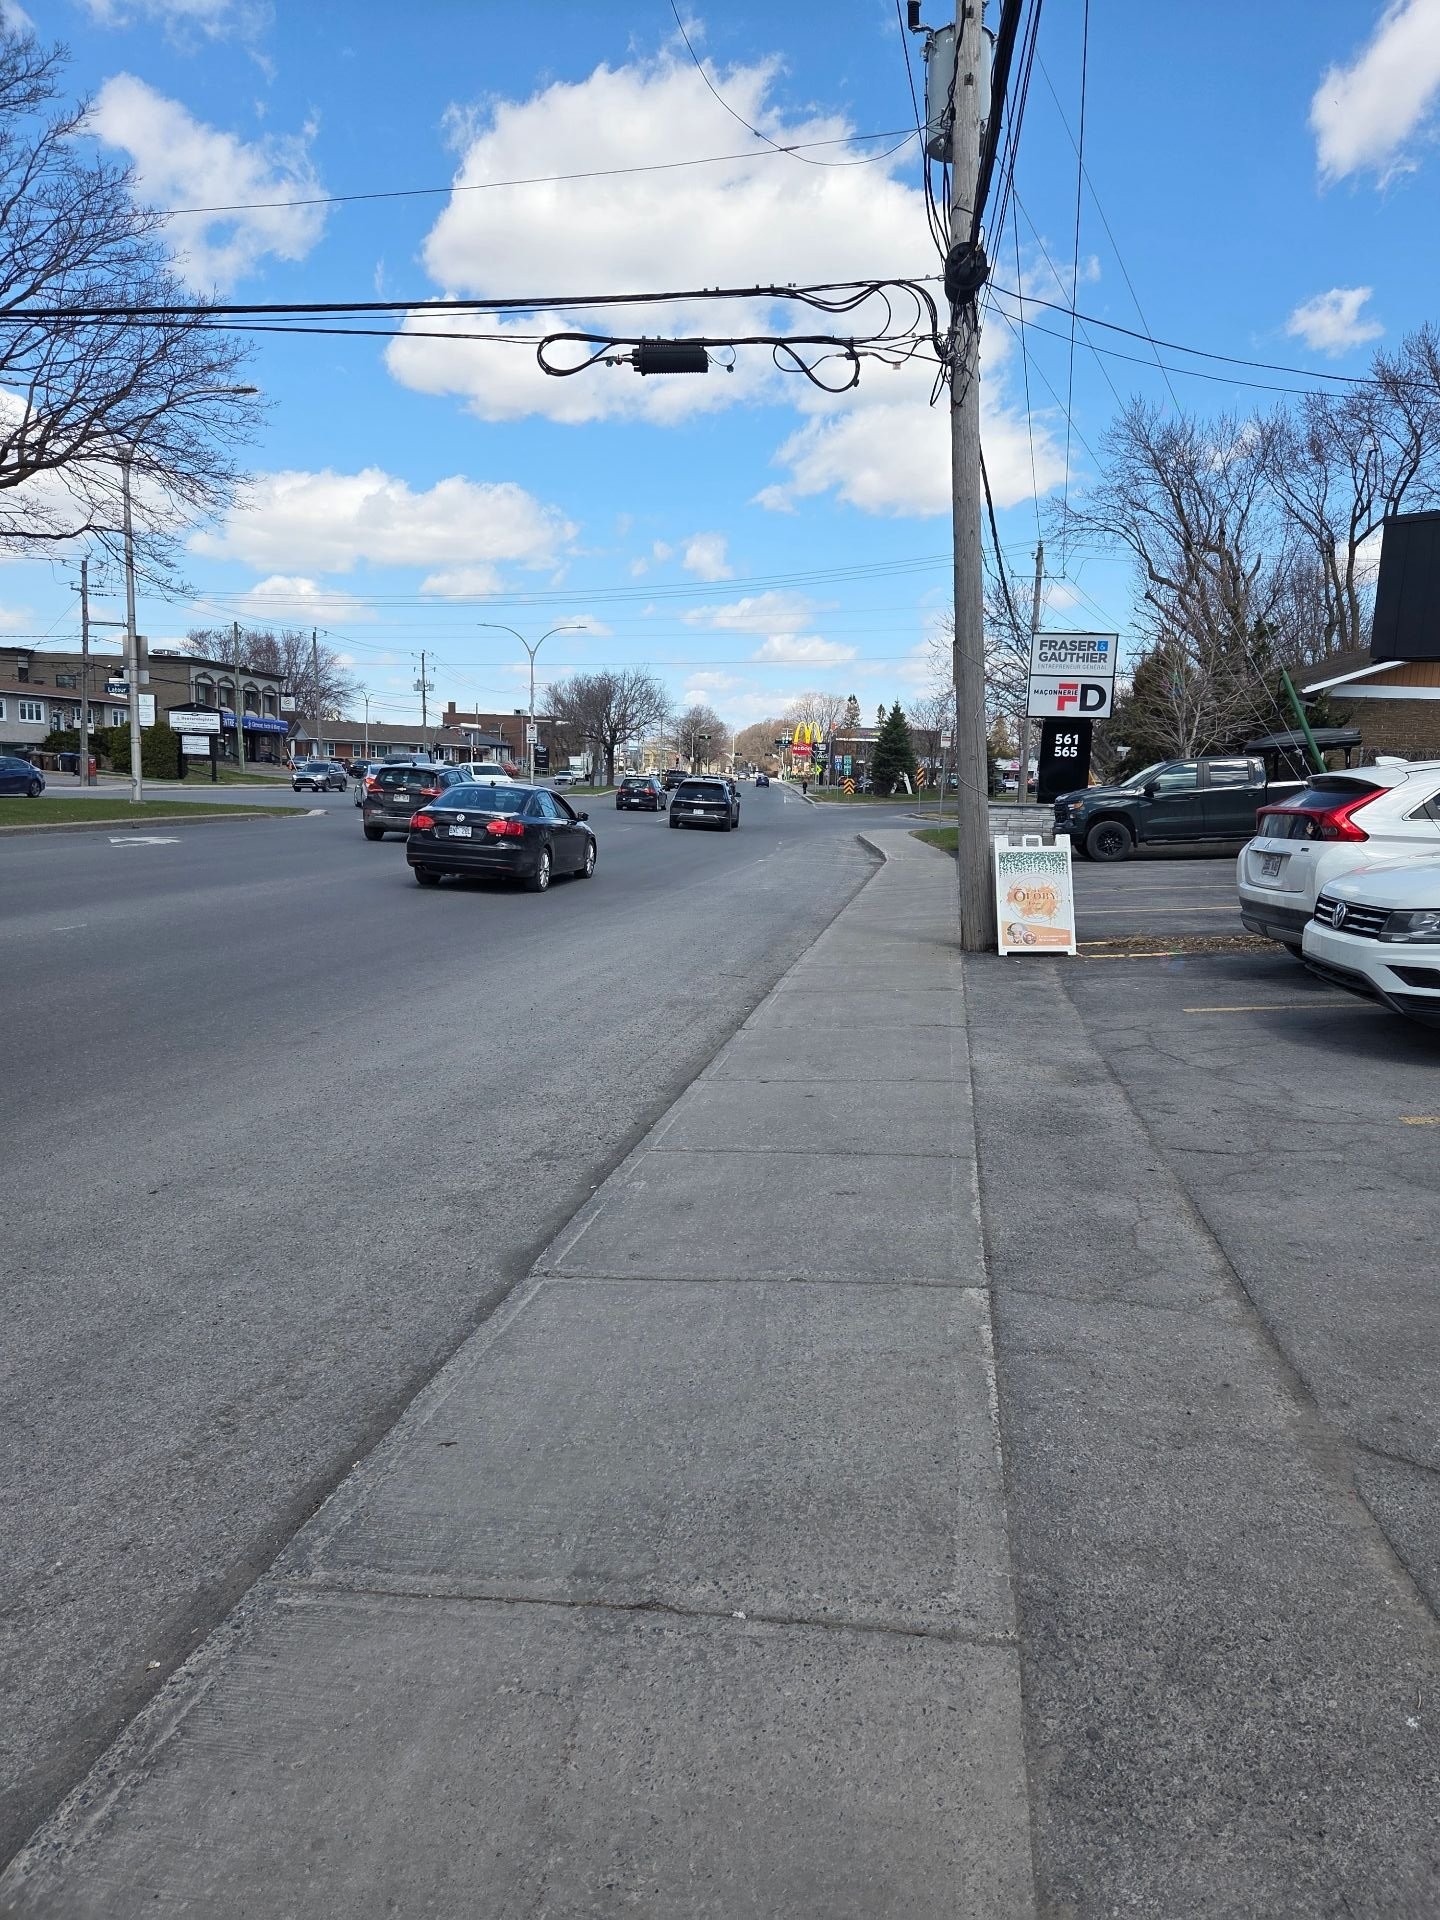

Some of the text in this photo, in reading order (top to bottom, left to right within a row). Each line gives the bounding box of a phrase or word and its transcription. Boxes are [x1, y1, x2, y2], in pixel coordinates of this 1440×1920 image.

[1039, 640, 1097, 652] FRASER
[1038, 651, 1108, 663] GAUTHIER
[1055, 733, 1079, 745] 561
[1054, 746, 1078, 758] 565
